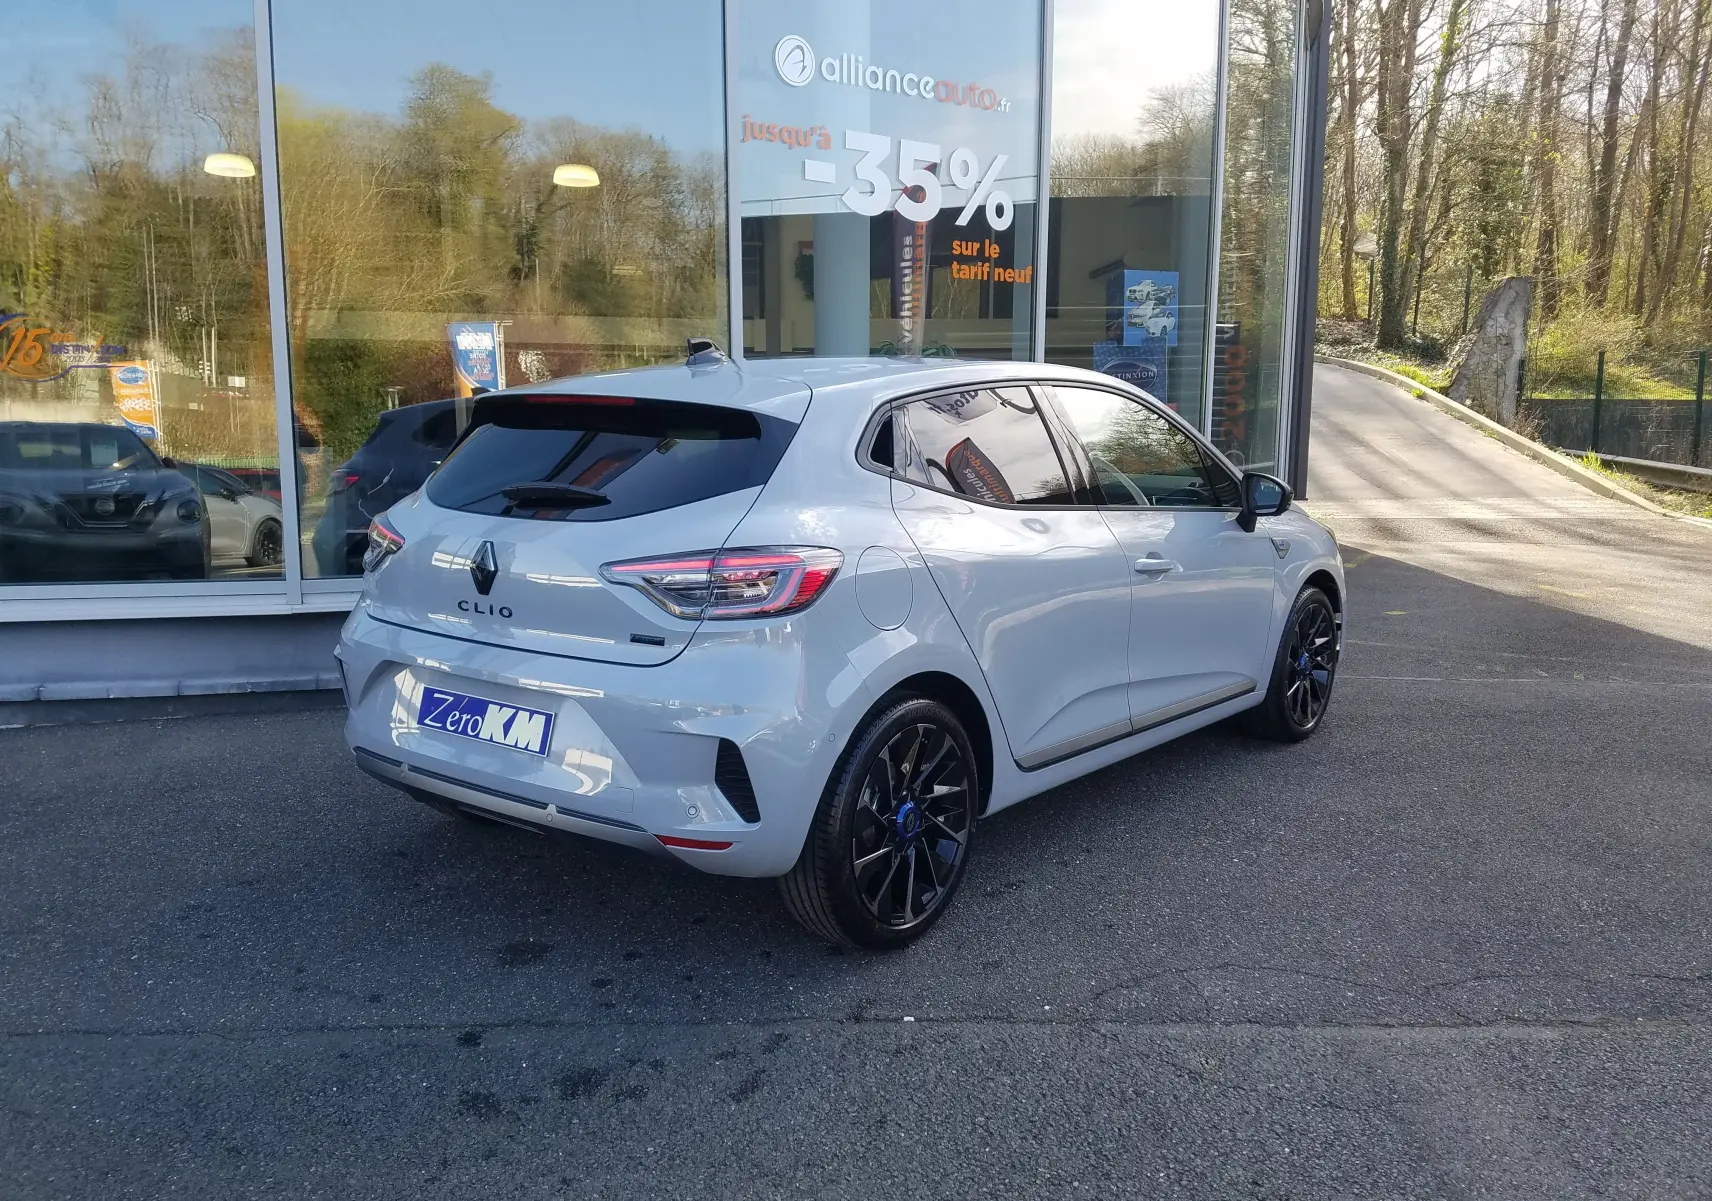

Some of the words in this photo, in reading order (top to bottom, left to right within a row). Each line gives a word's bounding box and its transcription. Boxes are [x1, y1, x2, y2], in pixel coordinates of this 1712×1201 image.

[820, 52, 1012, 113] allianceauto.fr
[741, 114, 832, 150] jusqu'à
[803, 129, 1014, 231] -35%
[952, 240, 980, 257] sur
[984, 238, 1000, 258] le
[951, 262, 990, 281] tarif
[993, 266, 1032, 284] neuf
[457, 600, 513, 618] CLIO
